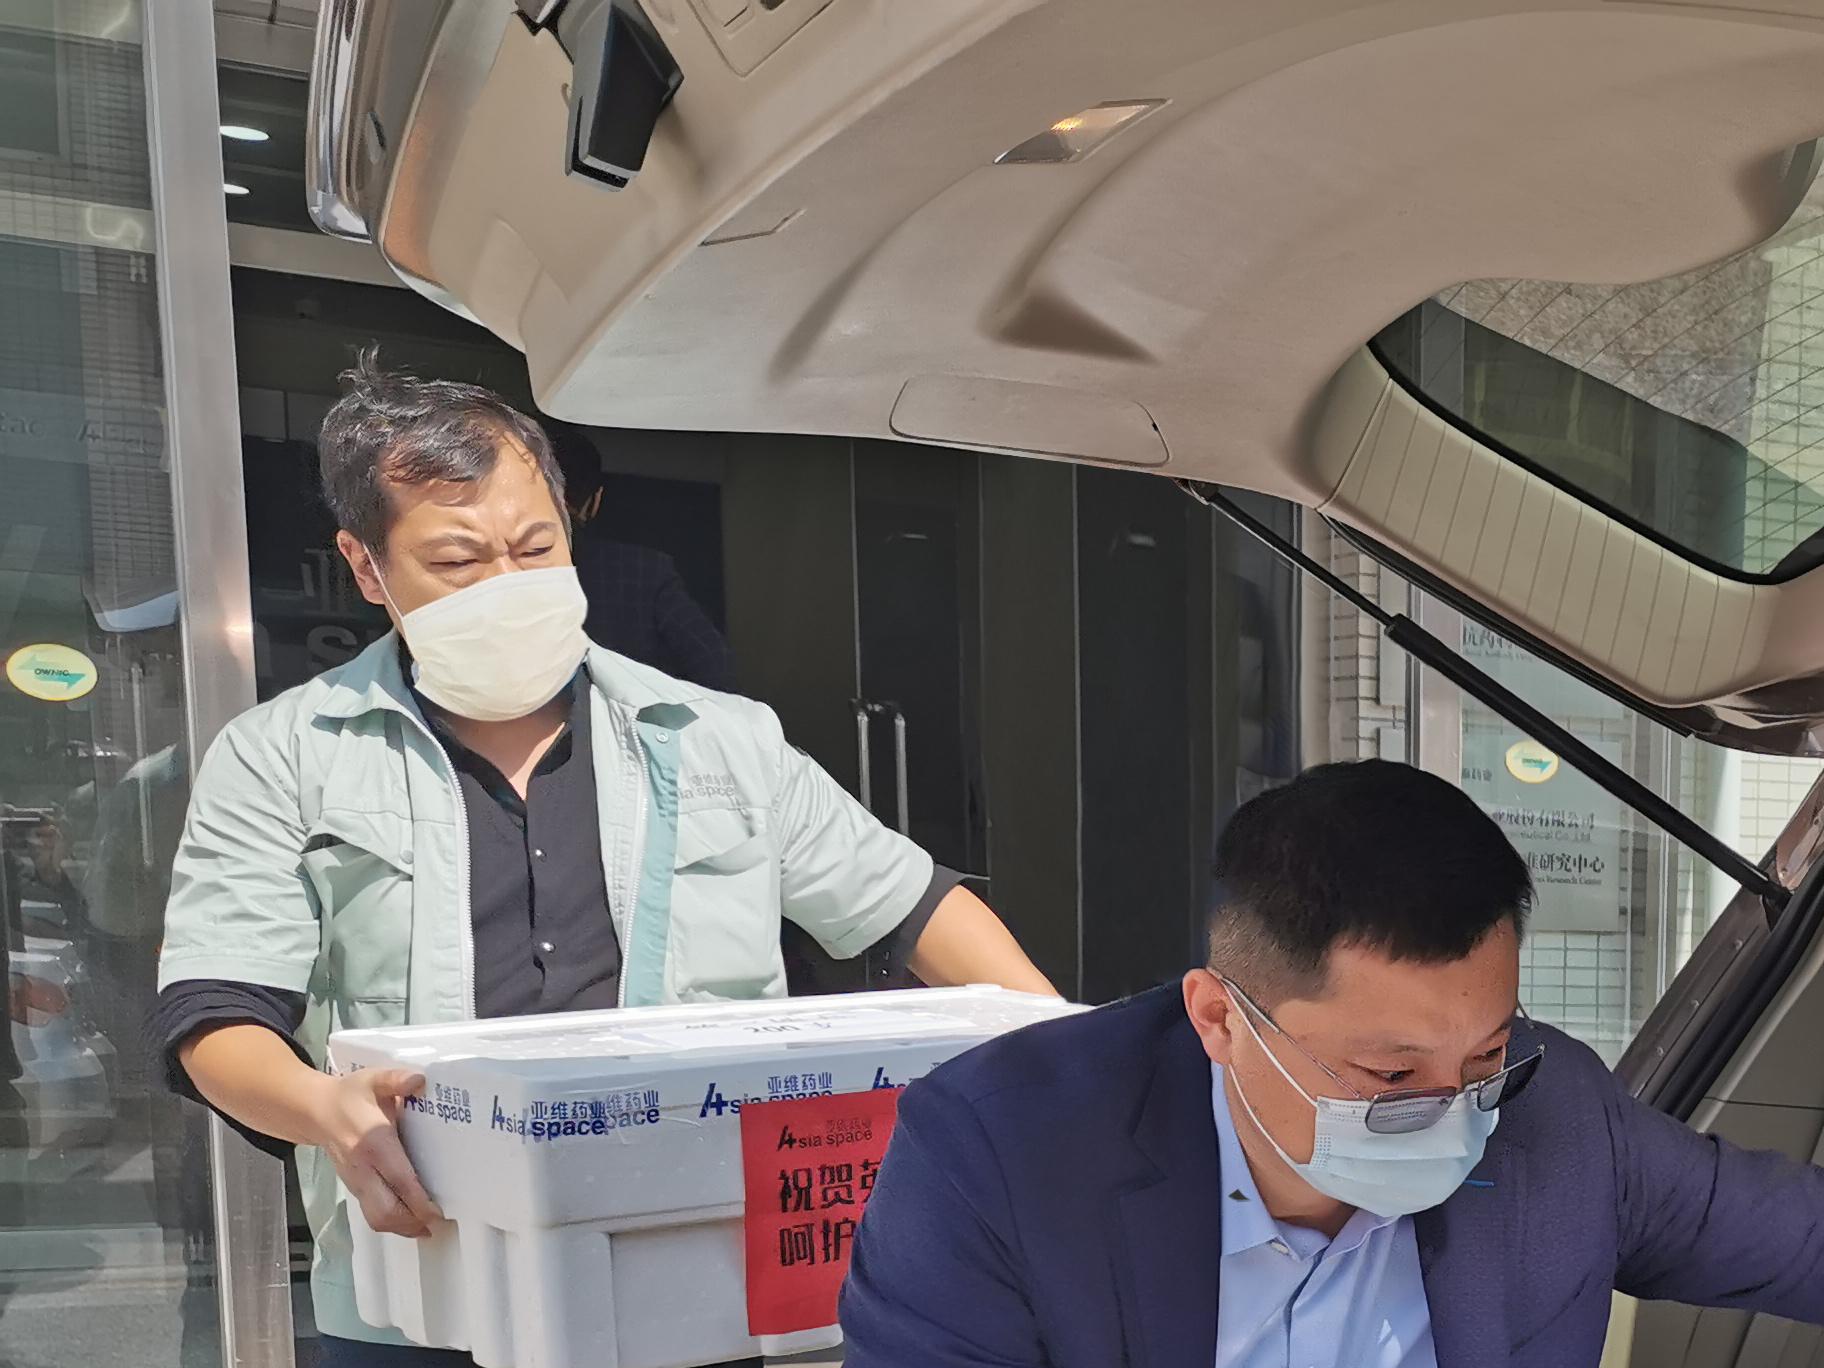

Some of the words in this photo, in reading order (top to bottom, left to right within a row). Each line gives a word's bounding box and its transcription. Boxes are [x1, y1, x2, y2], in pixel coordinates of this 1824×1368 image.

[768, 1072, 832, 1094] 亚维药业
[437, 1102, 472, 1124] space
[531, 1118, 607, 1142] space
[777, 1125, 822, 1151] Asia
[826, 1129, 873, 1147] space
[779, 1217, 857, 1267] 呵护
